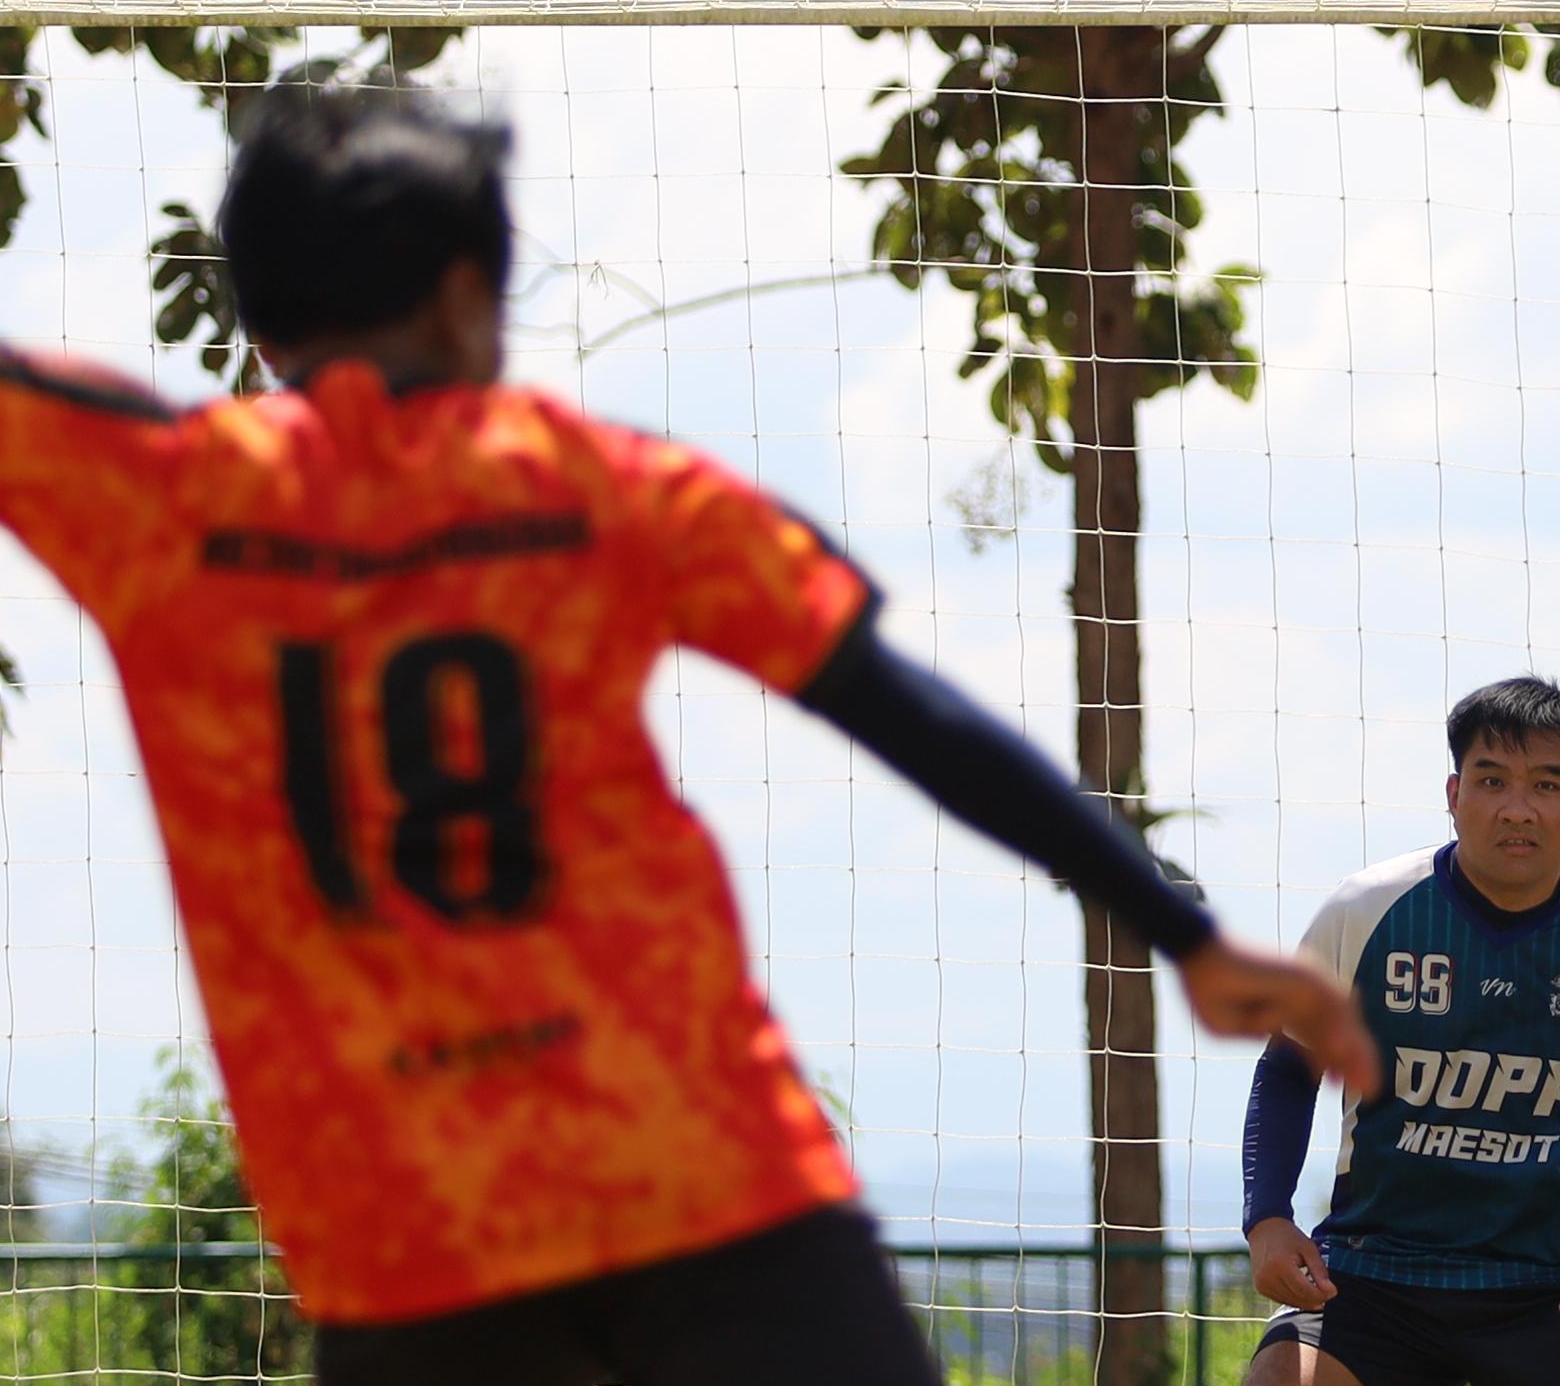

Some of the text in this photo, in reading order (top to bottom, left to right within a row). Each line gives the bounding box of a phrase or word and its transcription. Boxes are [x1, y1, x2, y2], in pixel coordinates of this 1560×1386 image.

[276, 631, 556, 927] 18
[1384, 950, 1451, 1016] 98
[1395, 1121, 1560, 1164] MAESOT
